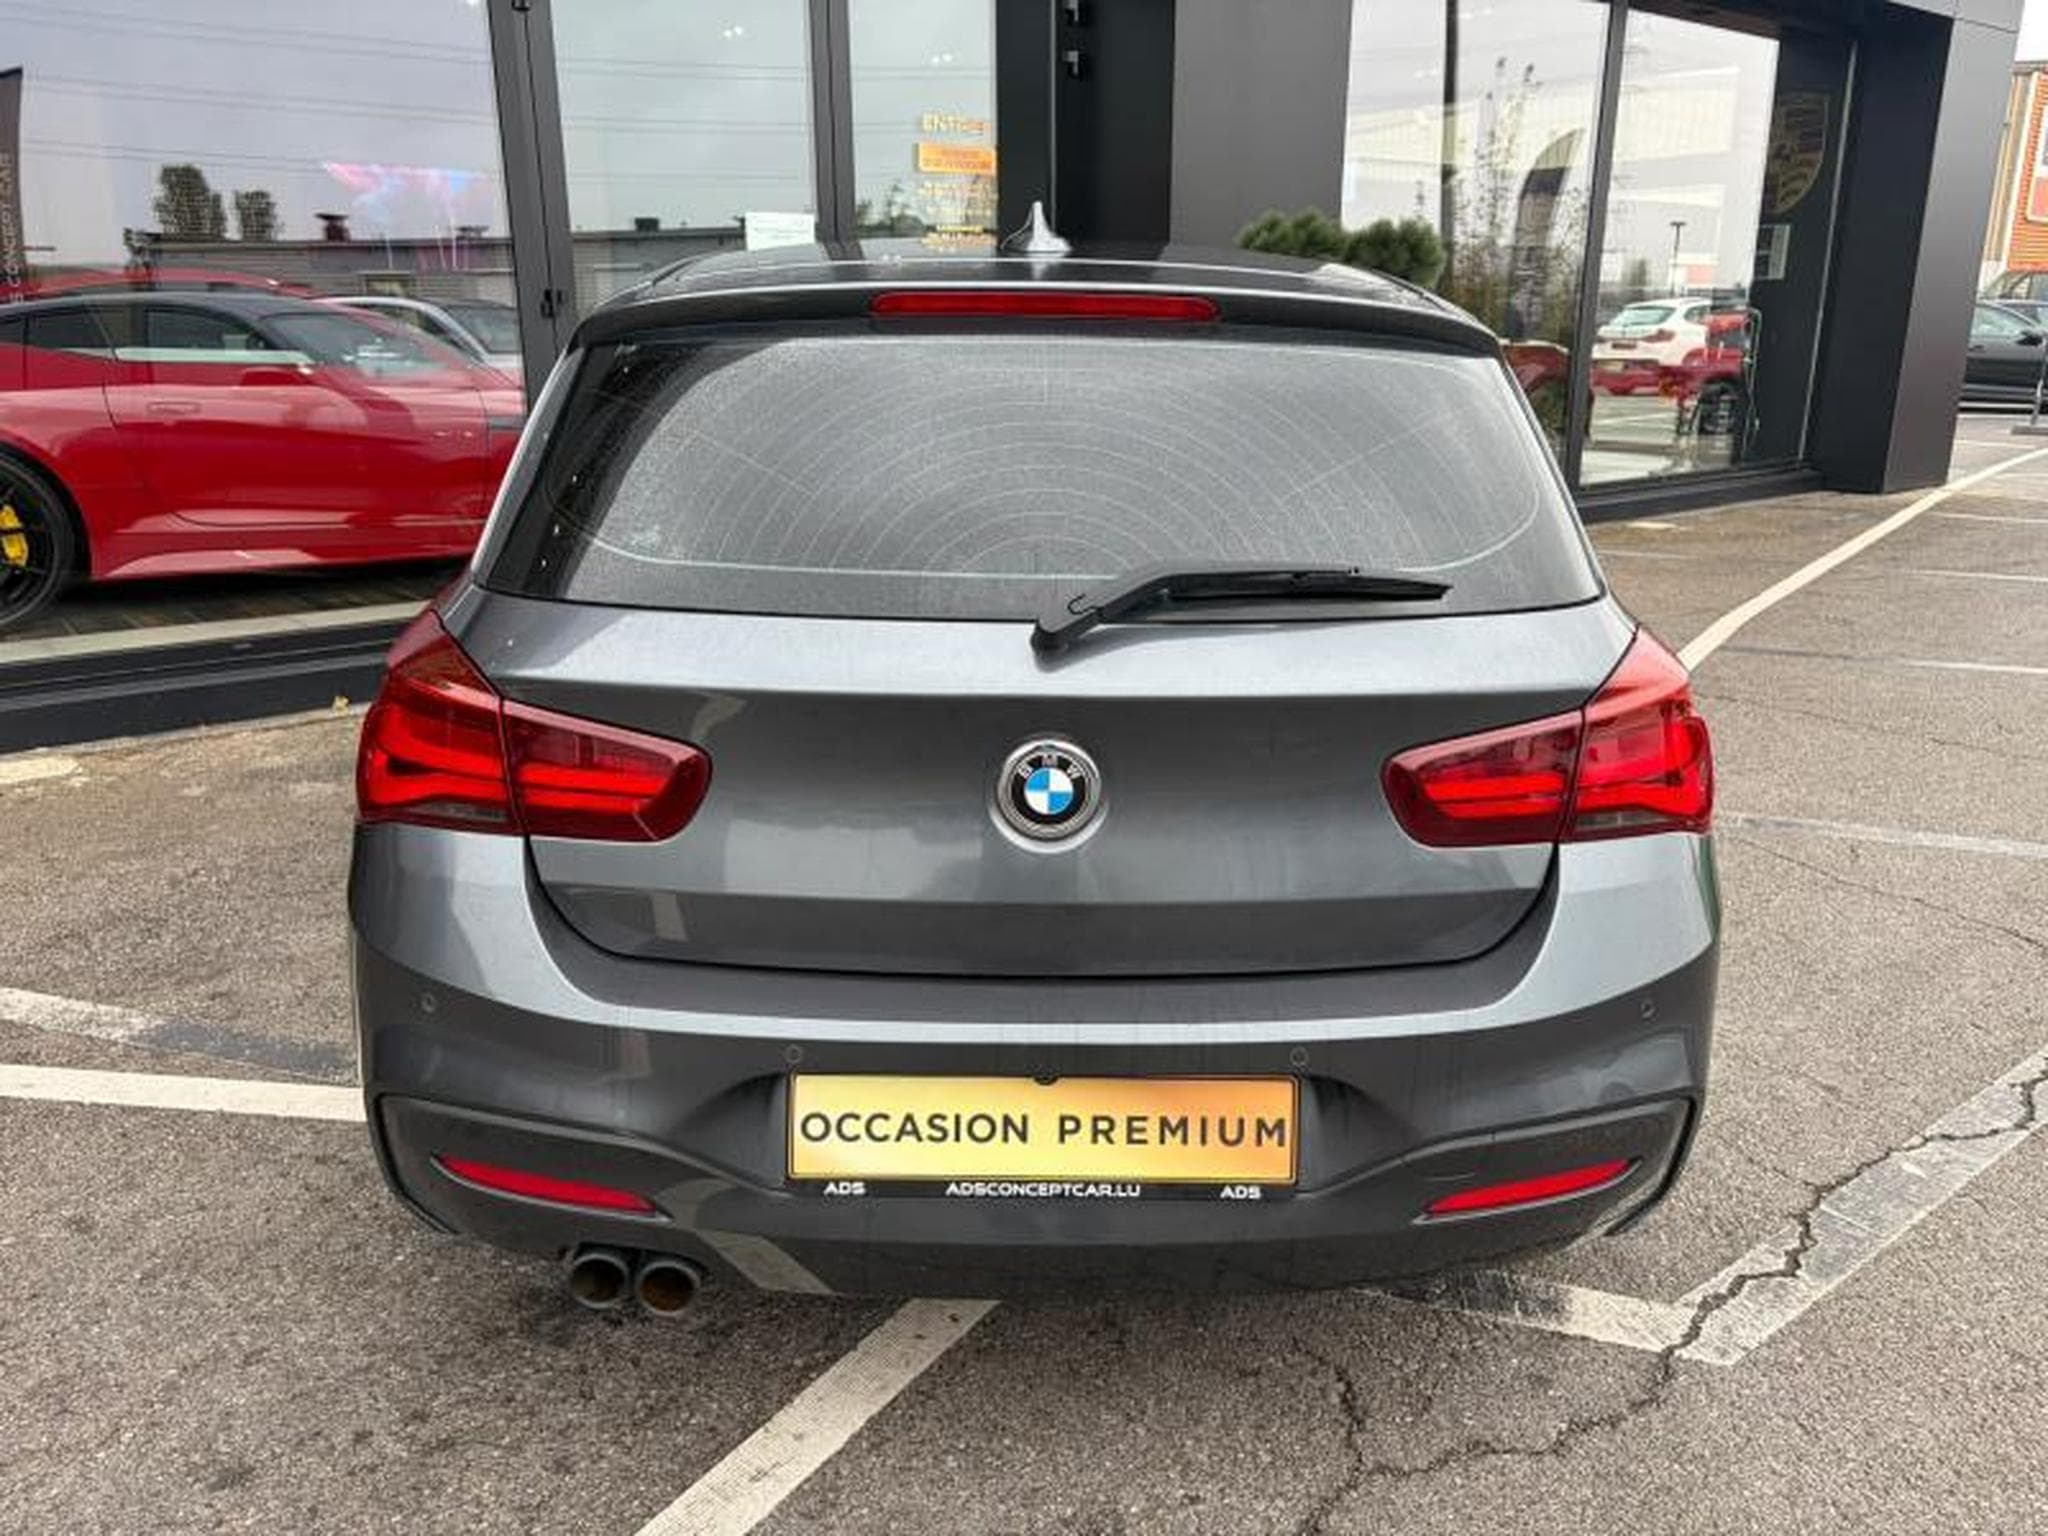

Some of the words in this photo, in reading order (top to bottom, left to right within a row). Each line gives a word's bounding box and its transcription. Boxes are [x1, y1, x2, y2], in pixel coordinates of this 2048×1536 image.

[1017, 753, 1082, 779] BMW
[800, 1112, 1029, 1144] OCCASION
[1057, 1115, 1286, 1147] PREMIUM
[823, 1182, 866, 1195] ADS
[945, 1182, 1141, 1197] ADSCONCEPTCAR.LU
[1220, 1185, 1262, 1199] ADS
